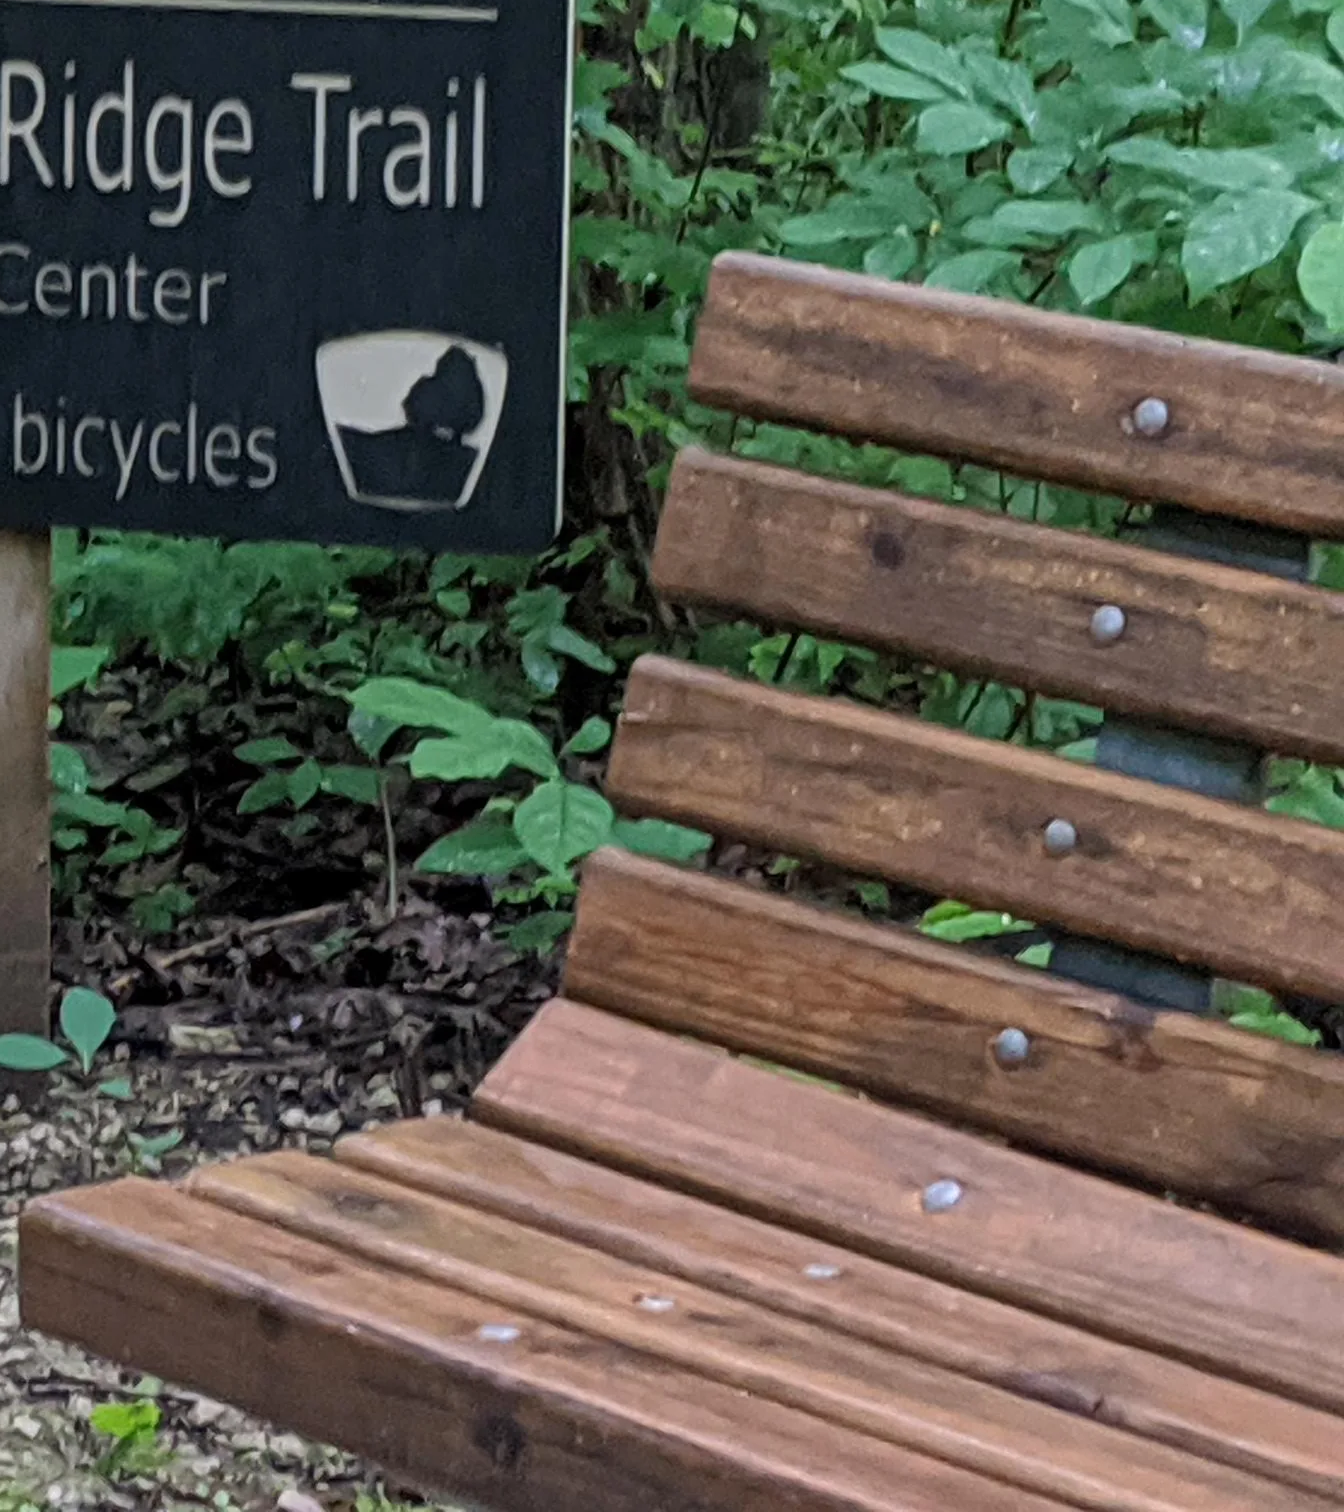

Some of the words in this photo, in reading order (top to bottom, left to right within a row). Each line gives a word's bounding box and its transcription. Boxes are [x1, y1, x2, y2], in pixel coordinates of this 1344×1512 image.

[0, 60, 253, 227] Ridge
[290, 72, 486, 209] Trail
[13, 393, 277, 501] bicycles
